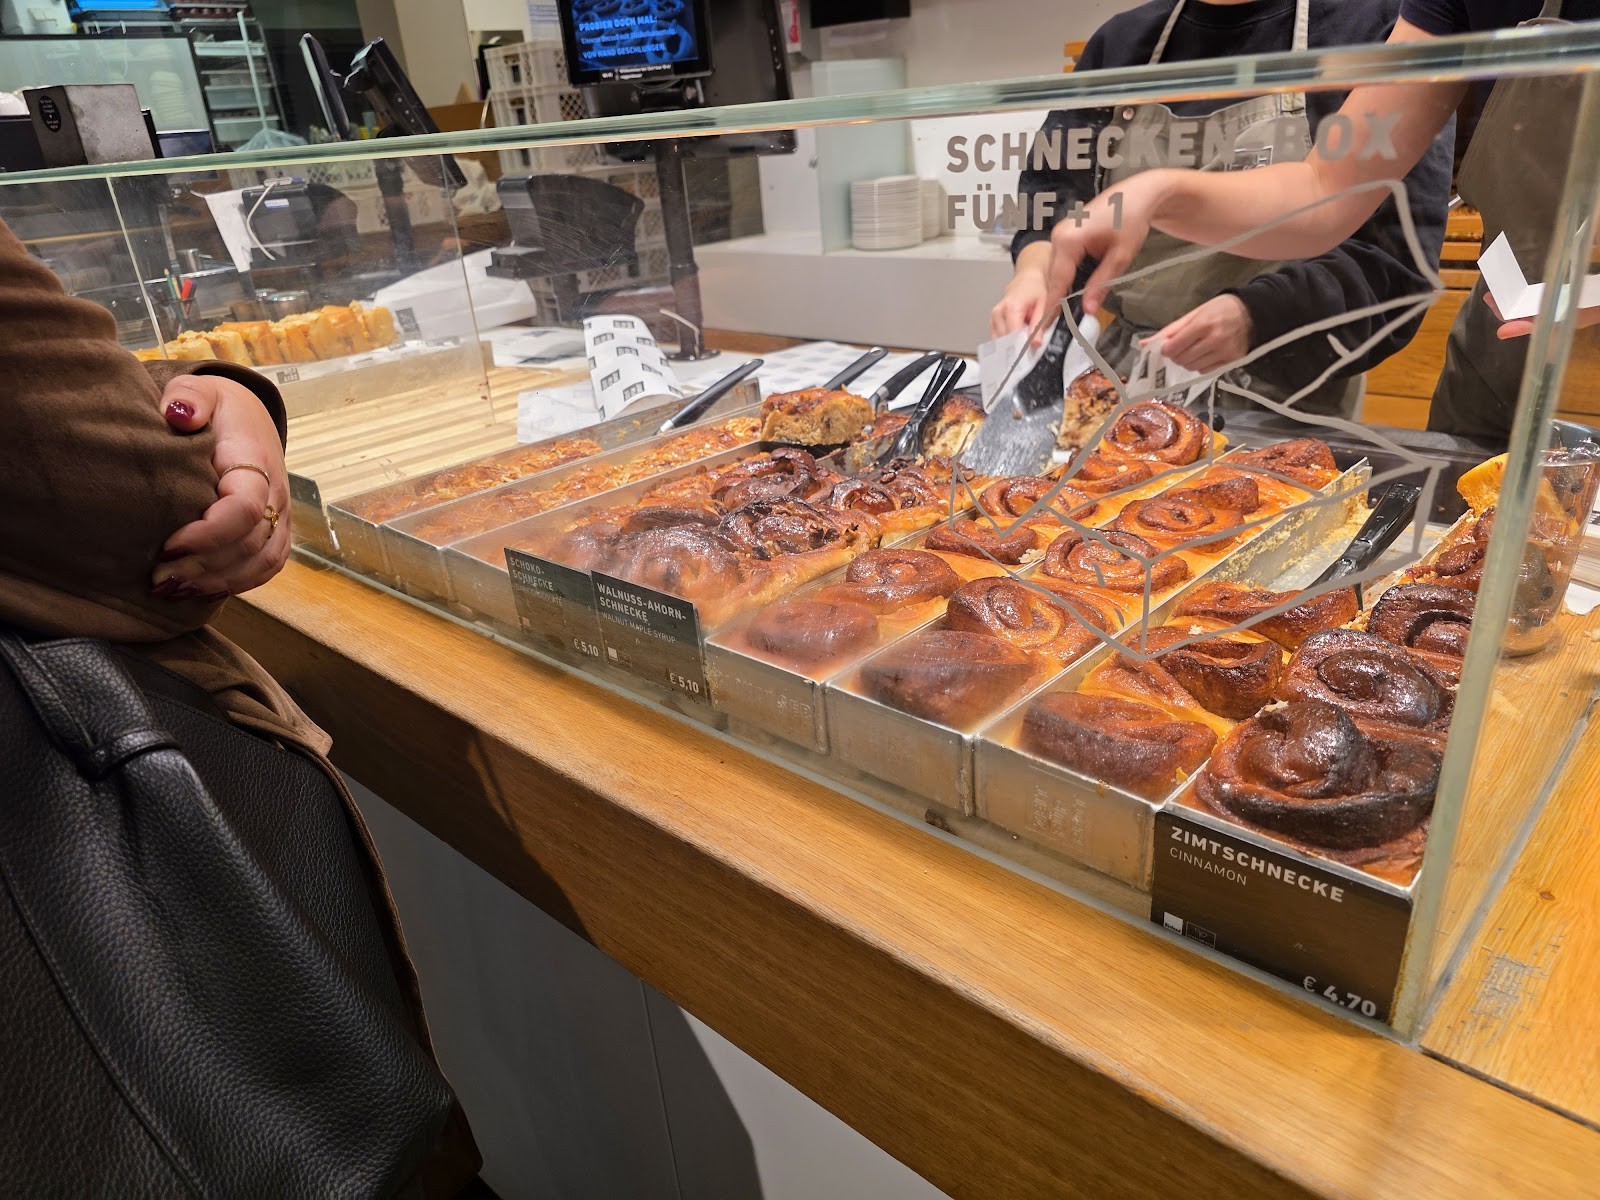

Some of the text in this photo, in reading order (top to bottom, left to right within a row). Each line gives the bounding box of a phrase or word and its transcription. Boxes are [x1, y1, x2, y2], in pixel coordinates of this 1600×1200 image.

[947, 184, 1124, 230] FÜNF + 1
[510, 557, 545, 575] SCHOKO-
[512, 569, 554, 592] SCHNECKE
[597, 582, 687, 621] WALNUSS-AHORN-
[600, 596, 649, 622] SCHNECKE
[602, 611, 676, 644] WALNUT MAPLE SYRUP
[669, 672, 677, 685] €
[1170, 847, 1248, 887] CINNAMON
[1171, 825, 1345, 903] ZIMTSCHNECKE
[1302, 975, 1377, 1017] € 4.70
